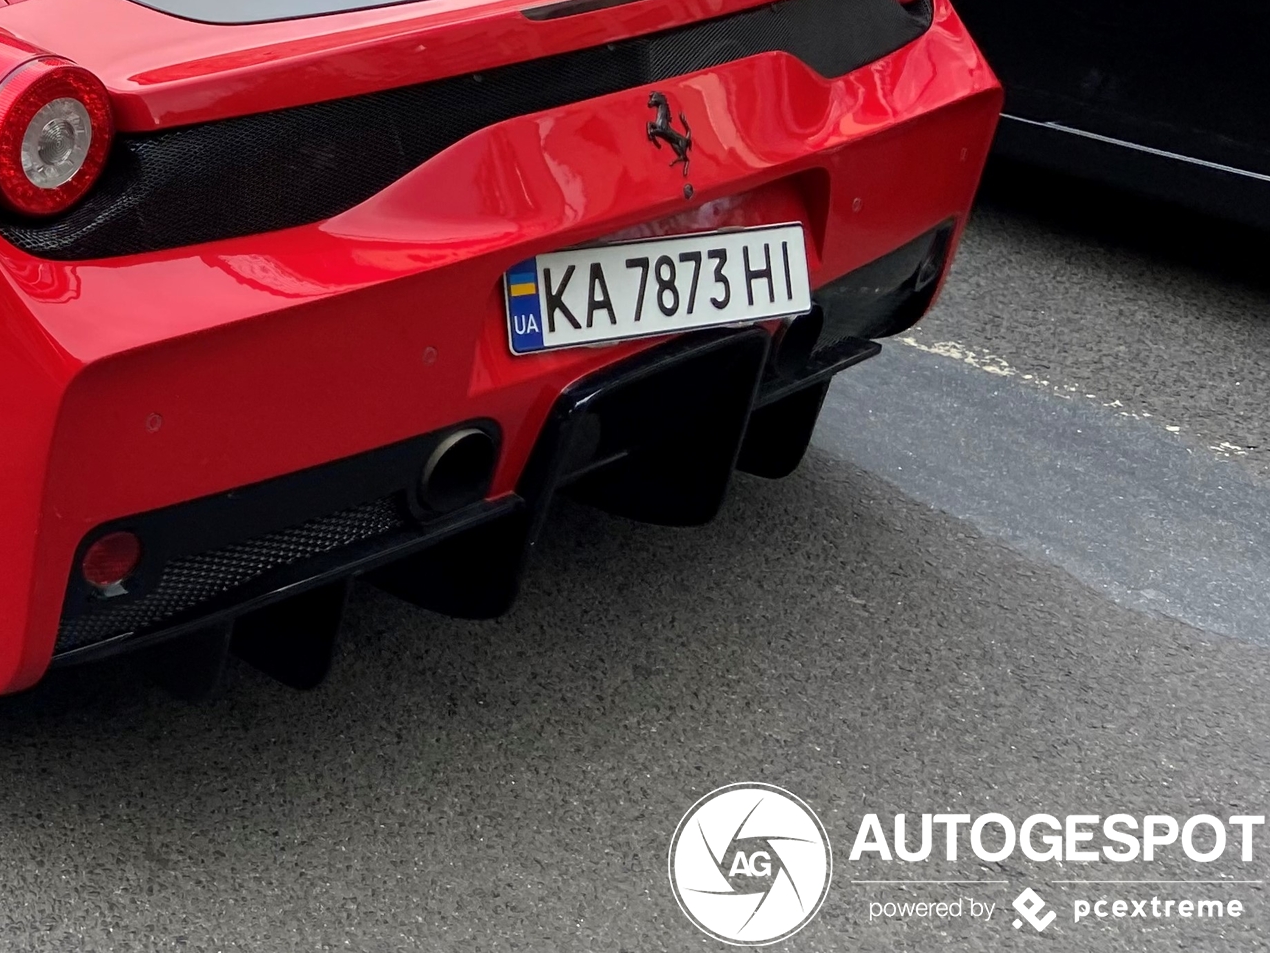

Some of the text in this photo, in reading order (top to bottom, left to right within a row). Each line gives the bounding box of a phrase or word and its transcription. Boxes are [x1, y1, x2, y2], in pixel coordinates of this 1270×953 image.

[543, 241, 793, 333] KA 7873 HI
[514, 313, 539, 335] UA
